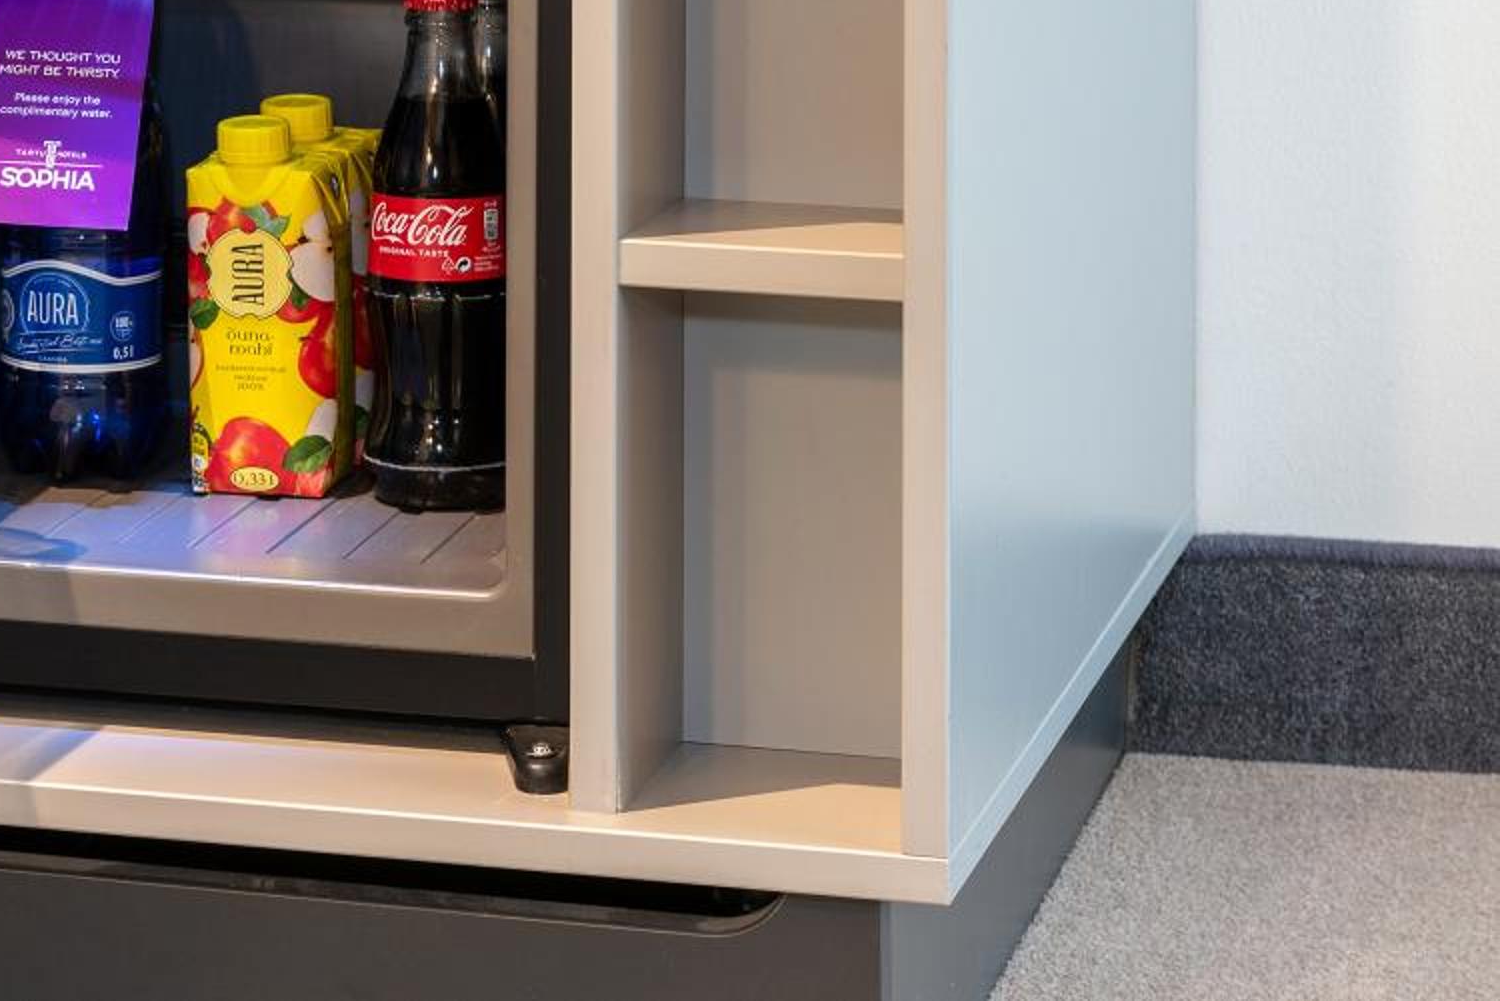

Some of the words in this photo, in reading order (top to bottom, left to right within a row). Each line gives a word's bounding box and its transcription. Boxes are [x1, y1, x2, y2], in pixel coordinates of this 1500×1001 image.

[5, 49, 26, 60] WE
[29, 50, 92, 62] THOUGHT
[94, 52, 121, 64] YOU
[0, 64, 40, 76] MIGHT
[43, 65, 62, 76] BE
[14, 92, 50, 104] Please
[52, 95, 80, 106] enjoy
[83, 95, 101, 105] the
[0, 106, 78, 119] complimentary
[81, 109, 113, 118] water.
[0, 166, 96, 192] SOPHIA
[371, 202, 474, 246] Coca-Cola
[378, 245, 417, 257] ORIGINAL
[419, 248, 450, 258] TASTE
[231, 243, 264, 305] AURA
[27, 290, 79, 326] AURA
